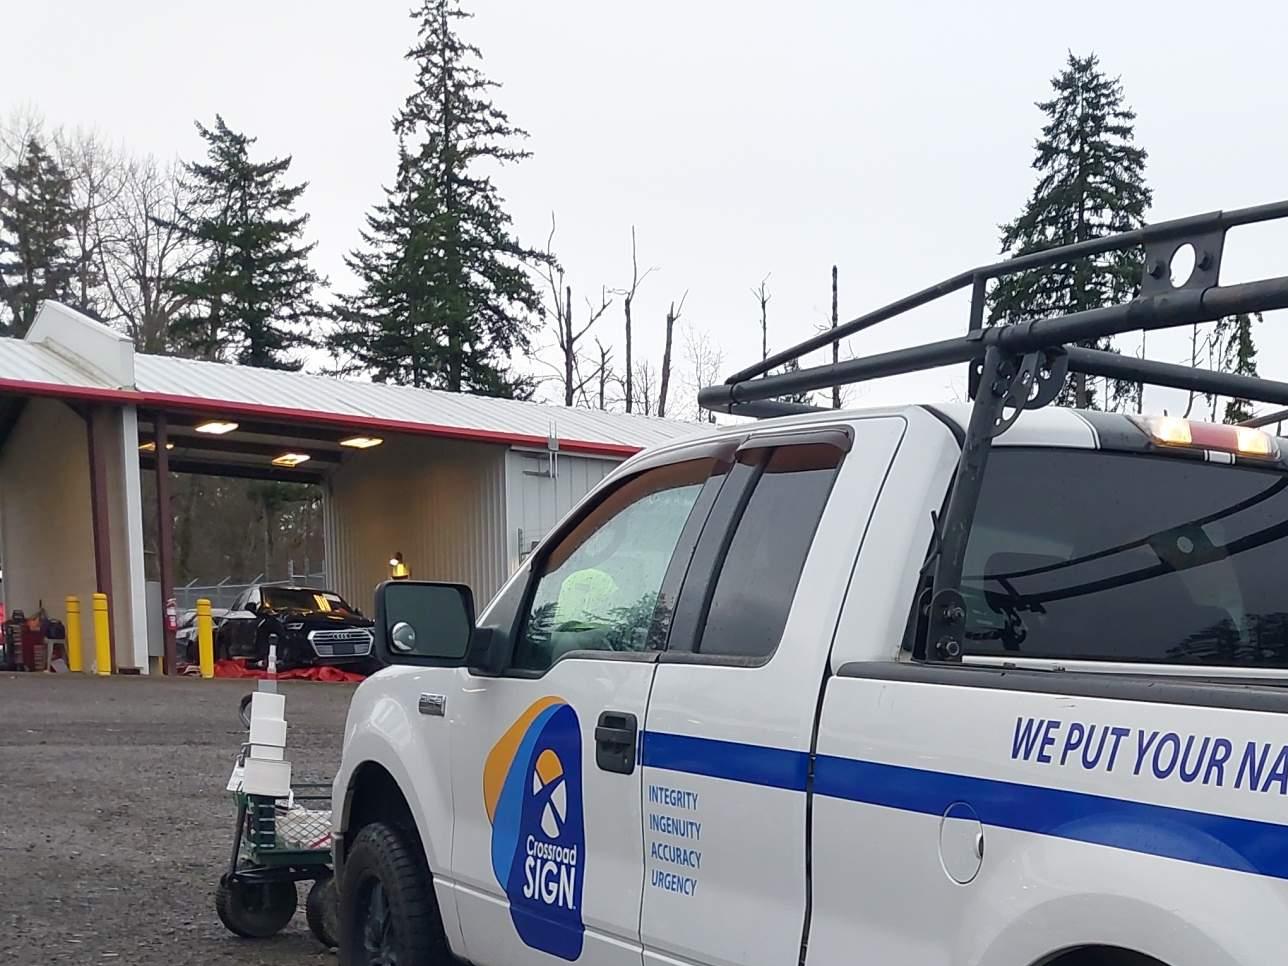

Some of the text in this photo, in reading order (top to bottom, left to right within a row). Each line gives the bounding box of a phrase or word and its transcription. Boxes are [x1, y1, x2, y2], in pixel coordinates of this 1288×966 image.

[1011, 717, 1061, 764] WE
[1060, 722, 1129, 772] PUT
[1132, 730, 1232, 787] YOUR
[649, 785, 698, 810] INTEGRITY
[649, 813, 701, 840] INGENUITY
[527, 834, 577, 866] Crossroad
[651, 842, 701, 869] ACCURACY
[523, 855, 576, 910] SIGN
[651, 870, 697, 897] URGENCY
